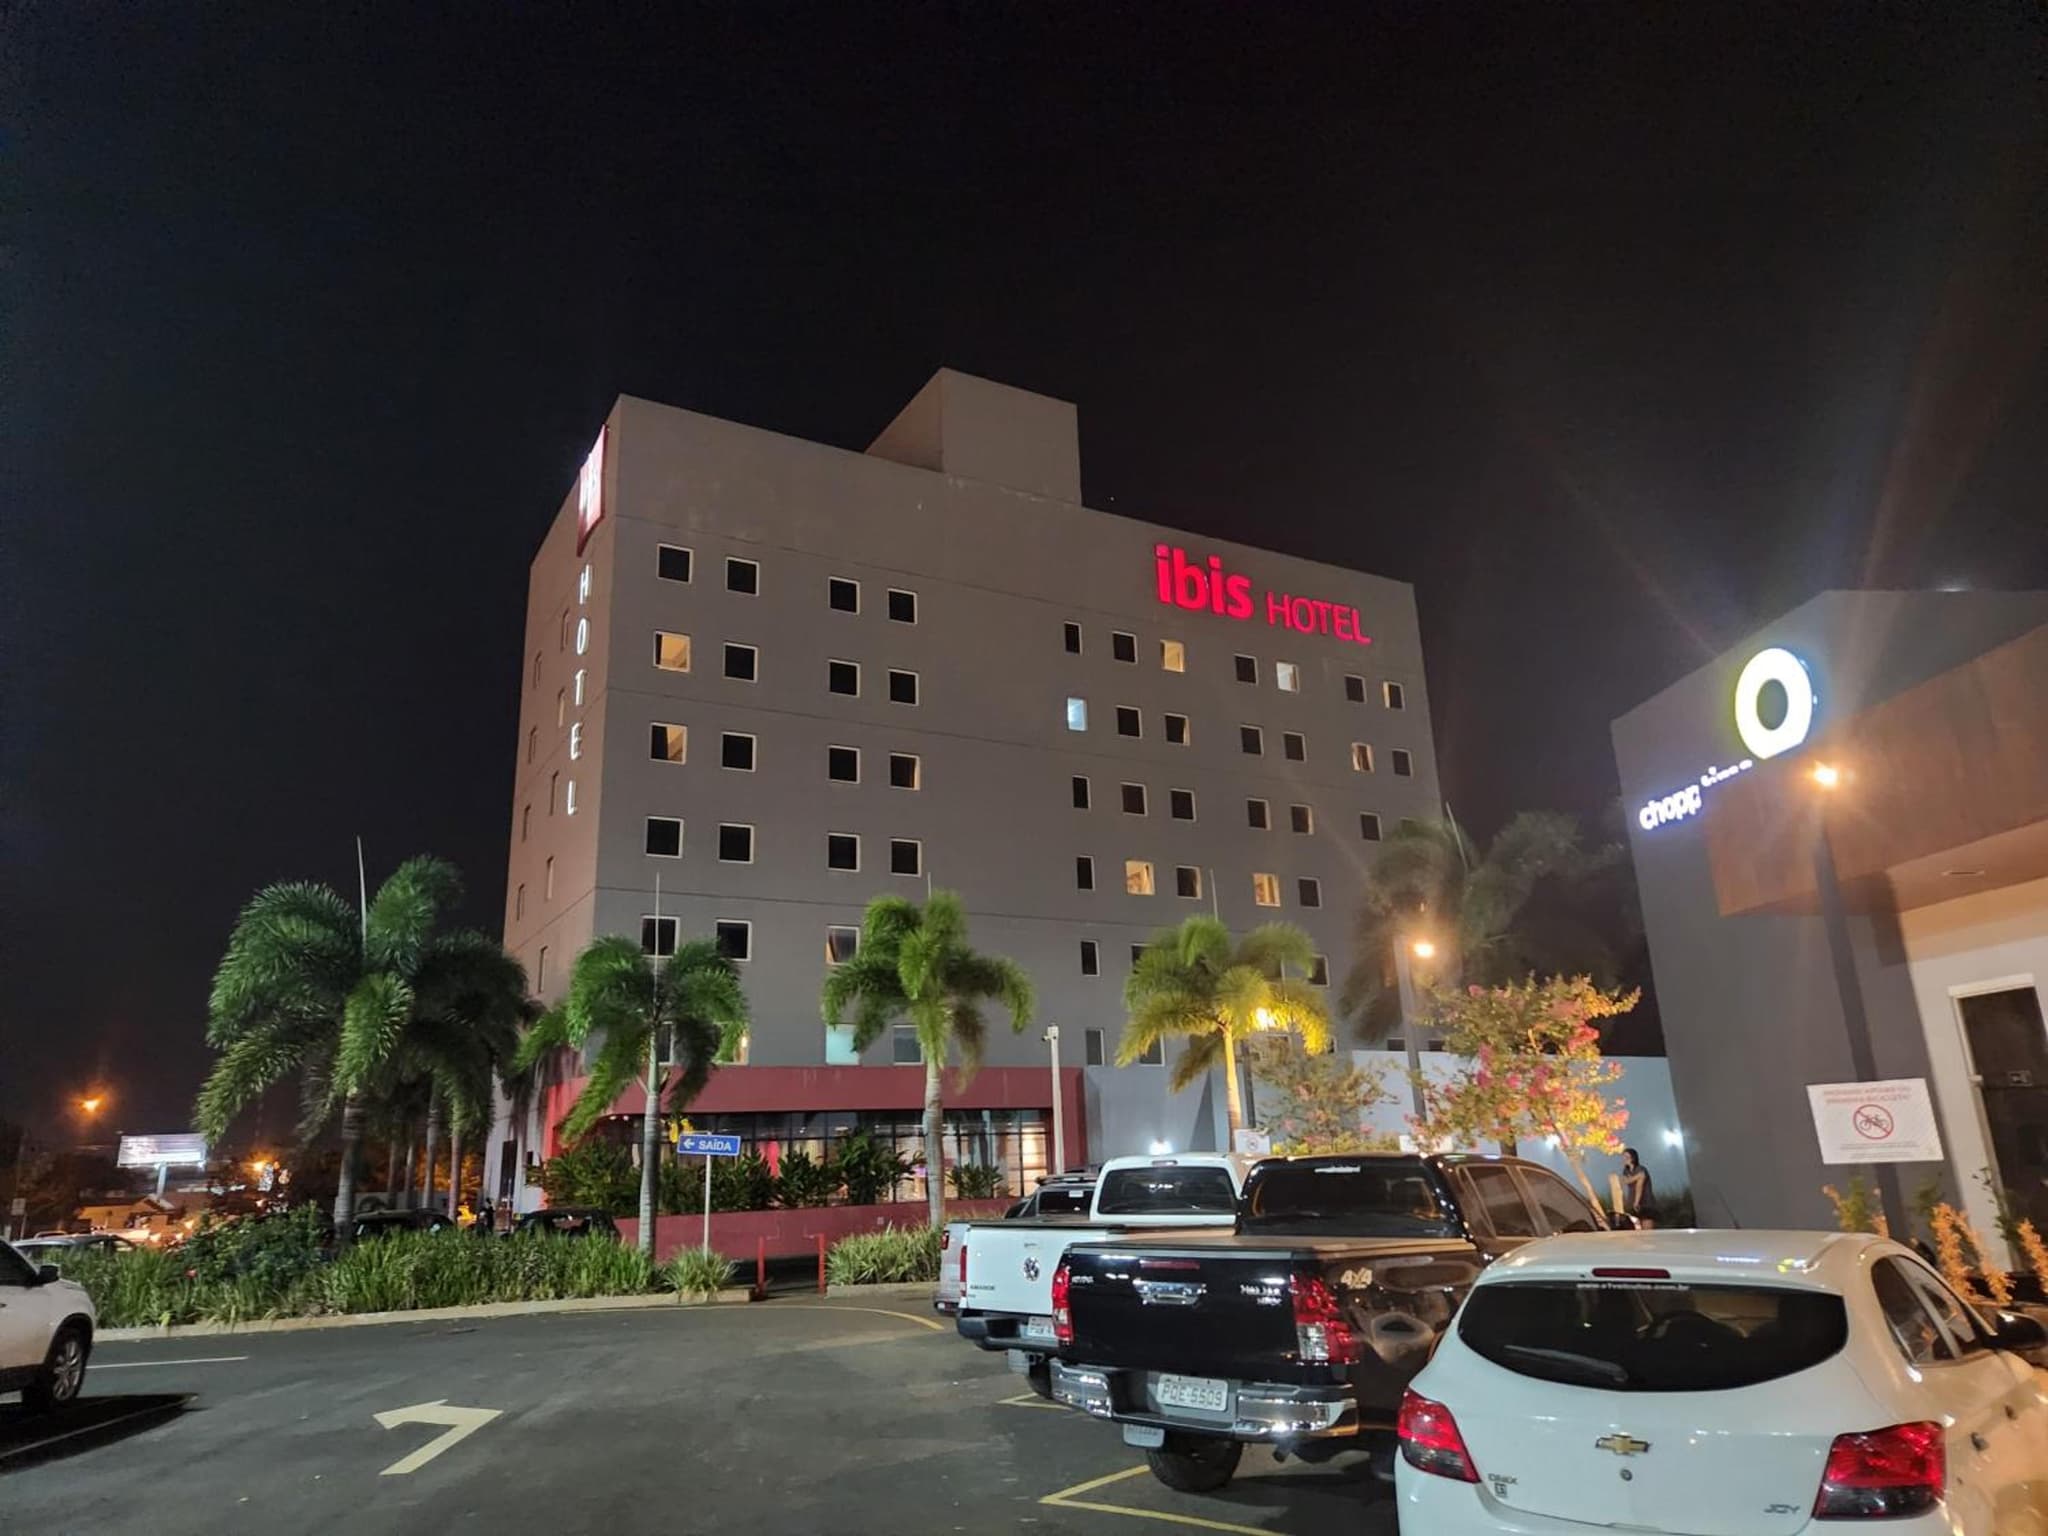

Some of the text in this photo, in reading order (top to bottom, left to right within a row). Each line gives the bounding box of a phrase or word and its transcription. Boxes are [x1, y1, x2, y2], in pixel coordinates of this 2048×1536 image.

[1154, 543, 1371, 645] ibis HOTEL
[567, 563, 592, 815] HOTEL
